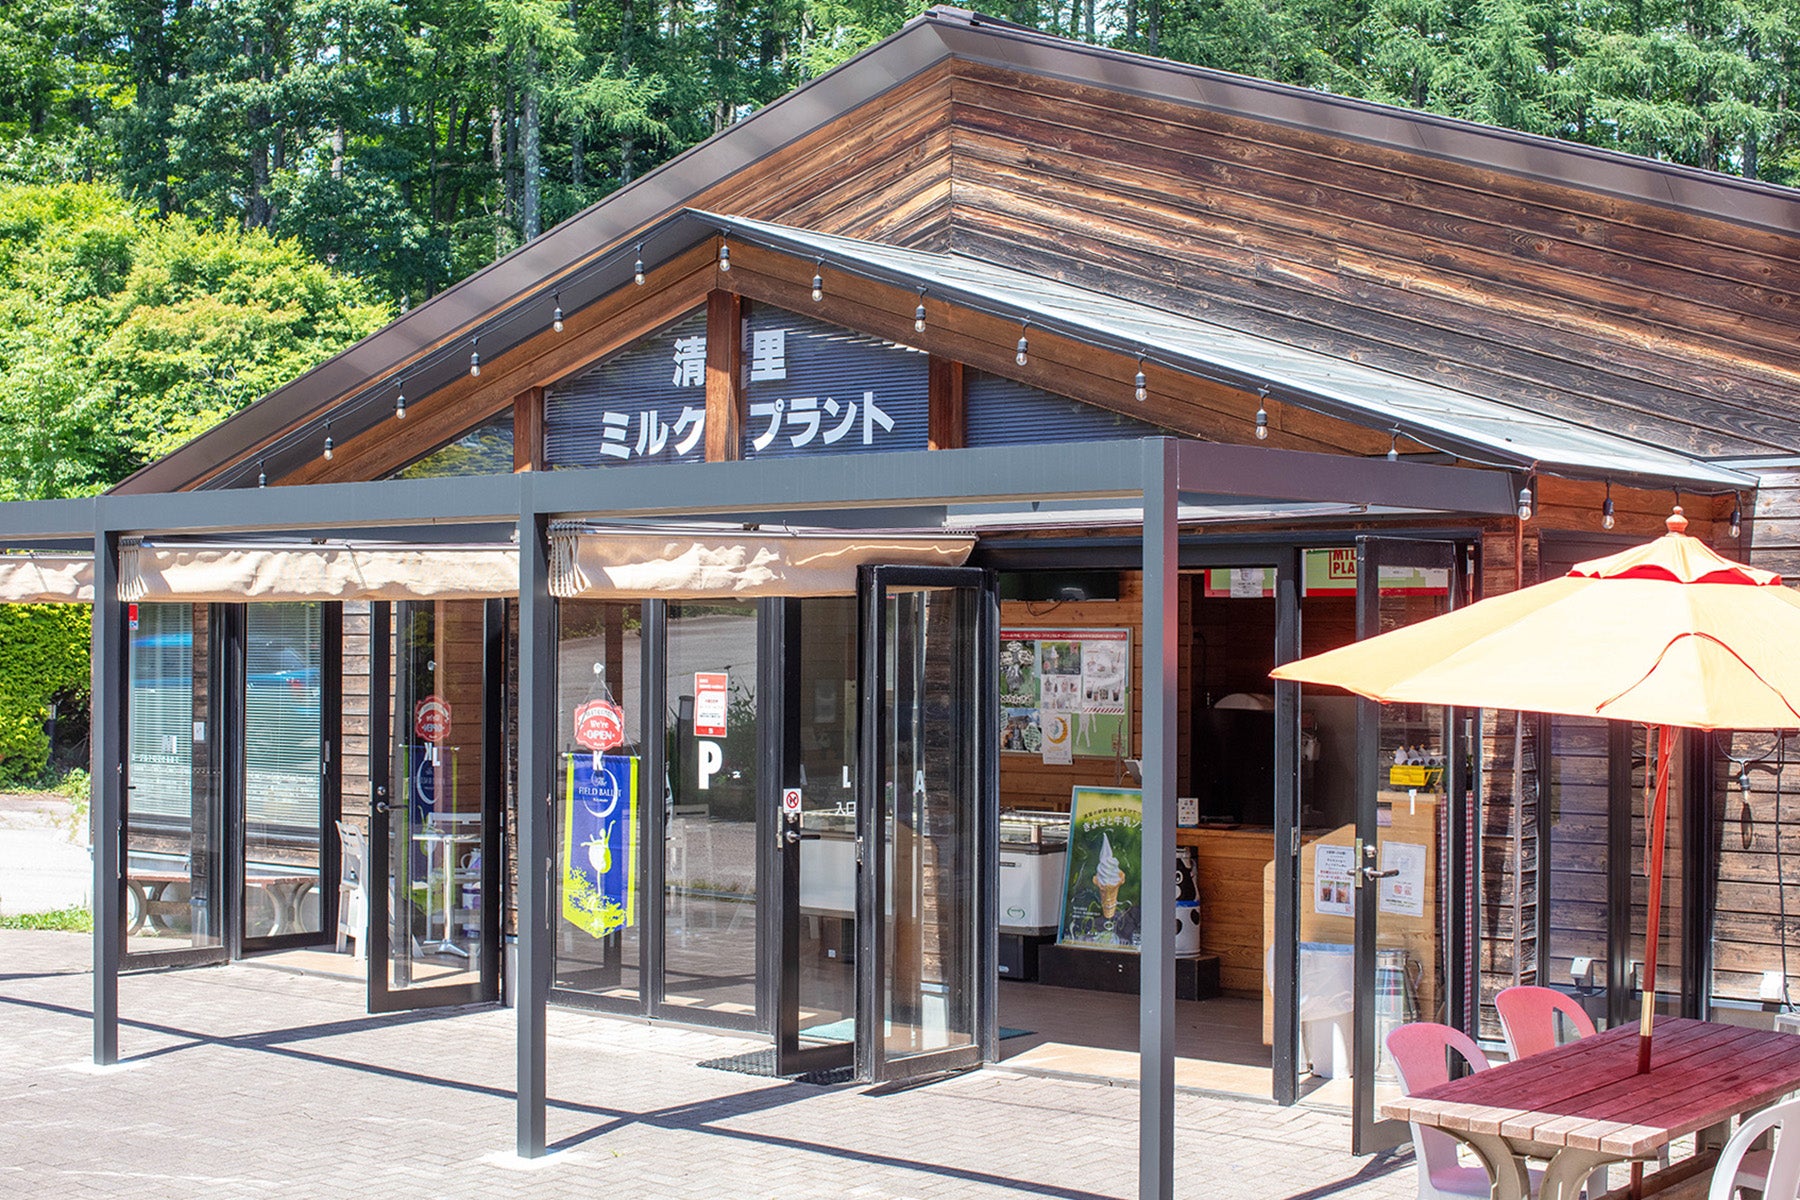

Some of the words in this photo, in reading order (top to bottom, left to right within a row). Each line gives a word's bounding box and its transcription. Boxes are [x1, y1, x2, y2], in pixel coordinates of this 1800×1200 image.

[586, 730, 612, 740] OPEN
[593, 751, 603, 771] K
[698, 740, 722, 789] P
[578, 786, 598, 796] FIELD
[1083, 815, 1142, 832] きよさと牛乳ソ
